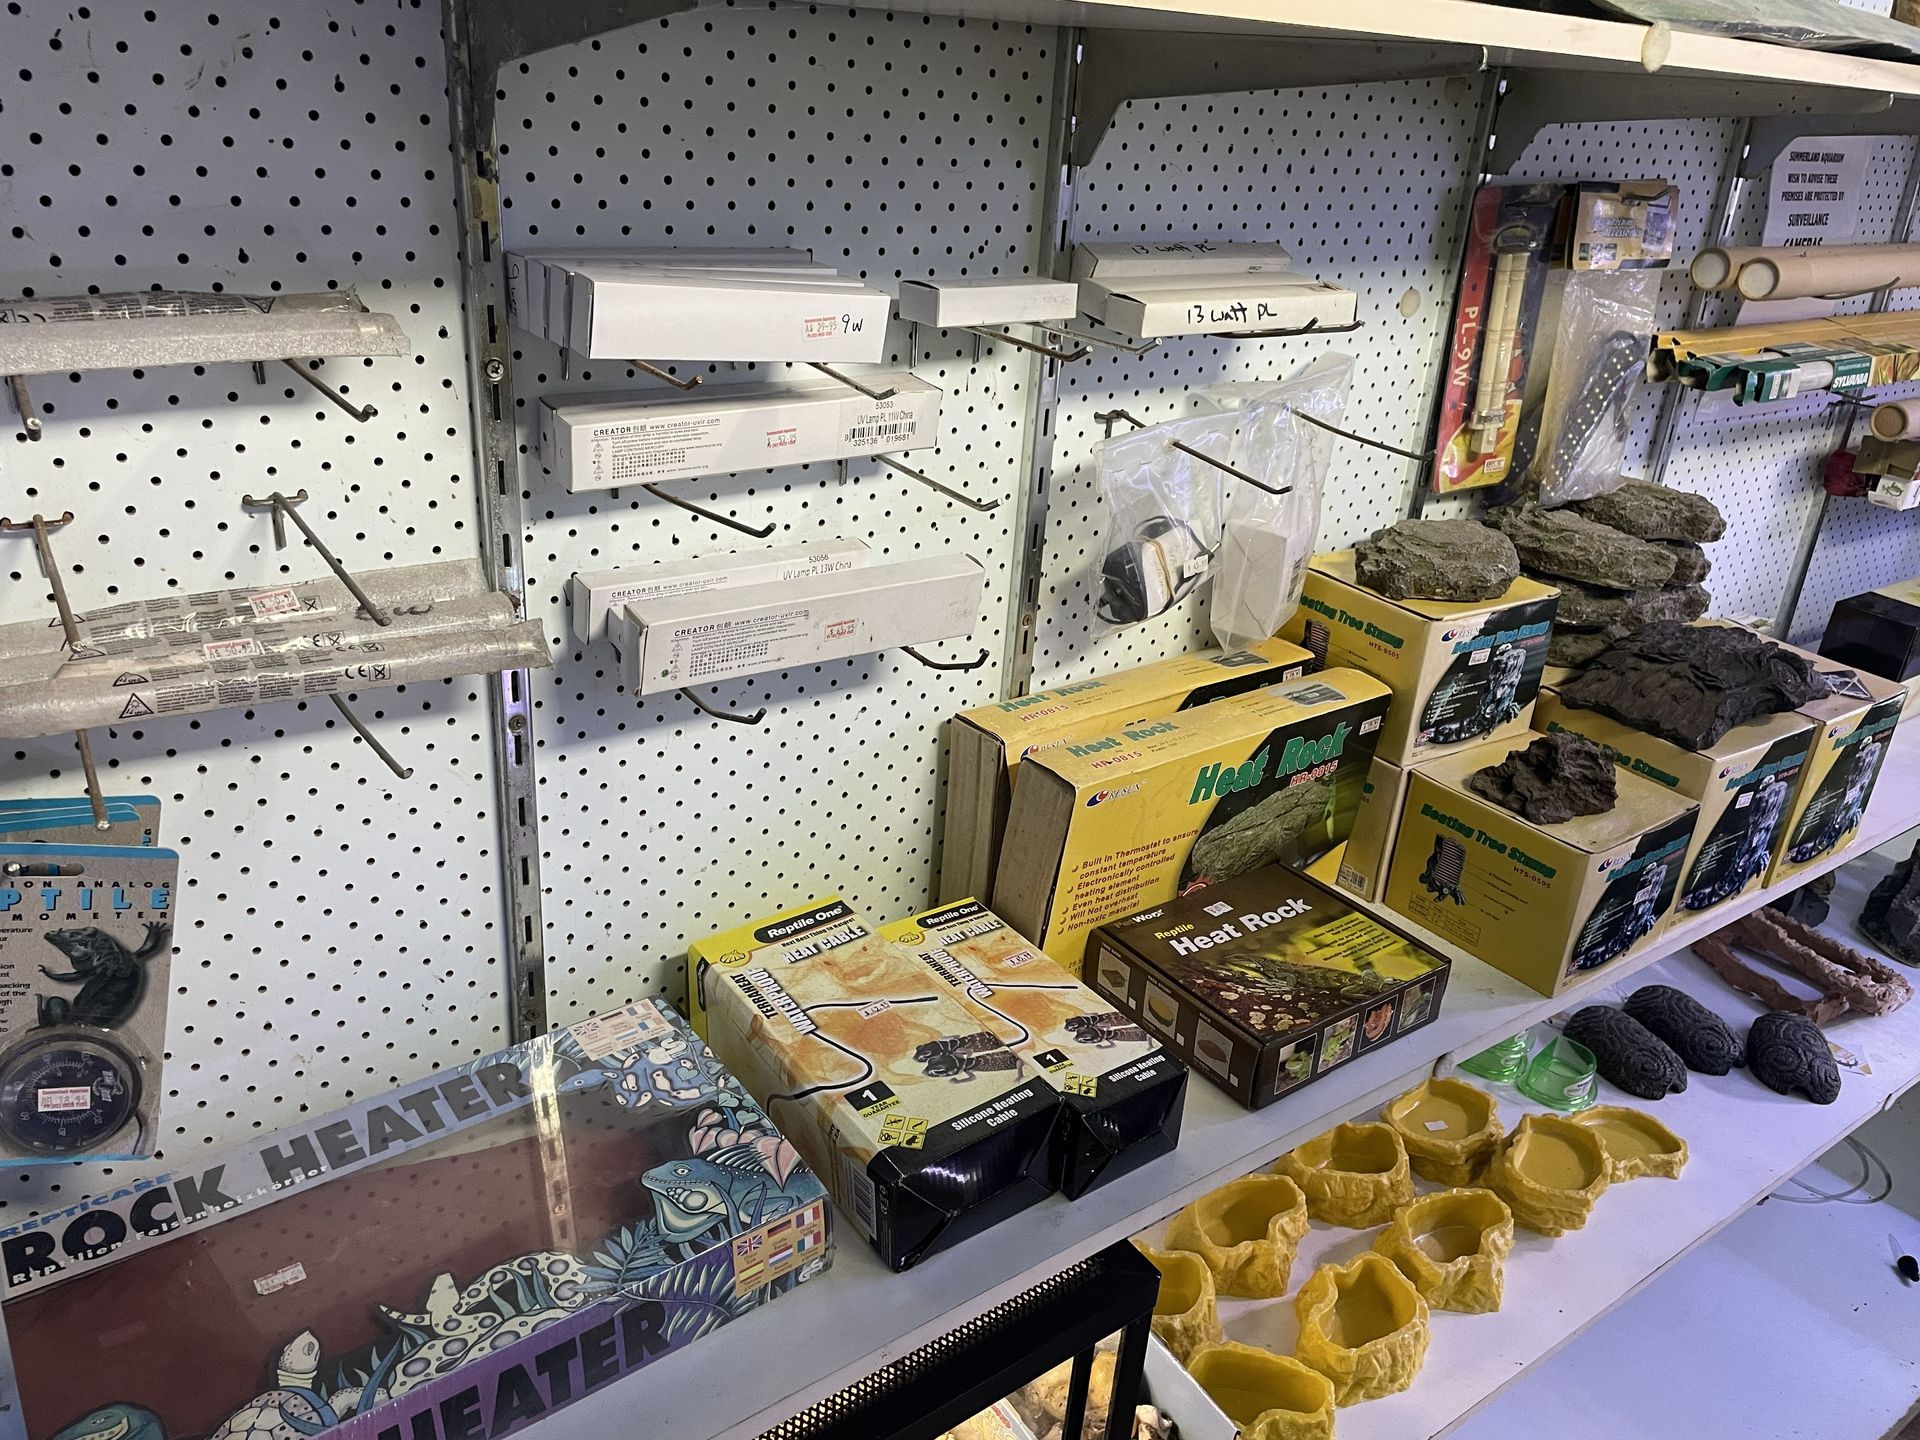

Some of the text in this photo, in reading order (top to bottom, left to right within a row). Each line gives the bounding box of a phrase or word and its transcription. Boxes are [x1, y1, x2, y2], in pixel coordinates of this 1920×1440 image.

[1821, 152, 1845, 164] AQUARIUM
[1788, 173, 1838, 184] WISH TO ADVISE THESE
[1782, 191, 1804, 201] PREMISES
[1804, 191, 1813, 201] ARE
[1814, 191, 1838, 201] PROTECTED
[1788, 213, 1829, 227] SURVEILLANCE
[1187, 302, 1278, 325] 13 watt PL
[1451, 306, 1479, 388] PL-9W
[1832, 373, 1869, 389] SYLVANIA
[857, 415, 865, 425] UV
[866, 414, 879, 425] Lamp
[881, 413, 887, 422] PL
[900, 411, 913, 421] China
[875, 401, 893, 410] 53053
[593, 426, 631, 437] CREATOR
[650, 418, 721, 430] www.creator-uvir.com
[854, 437, 878, 447] 325136
[886, 435, 910, 443] 019681
[783, 560, 852, 581] UV Lamp PL 13W China
[611, 588, 647, 599] CREATOR
[674, 624, 715, 637] CREATOR
[1300, 593, 1405, 649] eating Tree Stump
[999, 680, 1108, 713] Heat Rock
[1065, 736, 1124, 758] Heat
[1122, 720, 1180, 742] Rock
[1188, 722, 1353, 805] Heat Rock
[1082, 858, 1102, 869] Built
[1104, 855, 1112, 863] in
[1115, 840, 1161, 859] Thermostat
[1172, 830, 1198, 841] ensure
[1420, 803, 1557, 880] Heating Tree Stump
[1077, 853, 1176, 891] Electronically controlled
[1080, 848, 1166, 880] constant temperature
[1072, 877, 1160, 911] Even heat distribution
[1074, 875, 1140, 901] heating element
[12, 912, 167, 921] MOMETER
[926, 905, 978, 925] Reptile One
[1067, 900, 1140, 932] Non-toxic material
[1070, 892, 1138, 921] Will Not overheat
[767, 908, 842, 938] Reptile One
[781, 938, 795, 948] Next
[797, 933, 809, 943] Best
[809, 928, 826, 939] Thing
[834, 917, 855, 930] Nature!
[938, 920, 1002, 946] HEAT CABLE
[1154, 923, 1194, 940] Reptile
[1168, 923, 1243, 957] Heat
[1239, 899, 1313, 932] Rock
[783, 926, 866, 964] HEAT CABLE
[918, 952, 961, 988] TERRAHEAT
[730, 973, 779, 1019] TERRAHEAT
[743, 968, 817, 1035] WATERPROOF
[1046, 1053, 1058, 1063] 1
[1108, 1054, 1166, 1083] Silicone Heating
[1134, 1069, 1157, 1082] Cable
[862, 1089, 878, 1102] 1
[871, 1101, 888, 1111] YEAR
[863, 1100, 901, 1118] GUARANTEE
[951, 1088, 1034, 1131] Silicone Heating
[986, 1108, 1019, 1127] Cable
[1, 1062, 533, 1288] ROCK HEATER
[0, 1172, 173, 1239] REPTICARE
